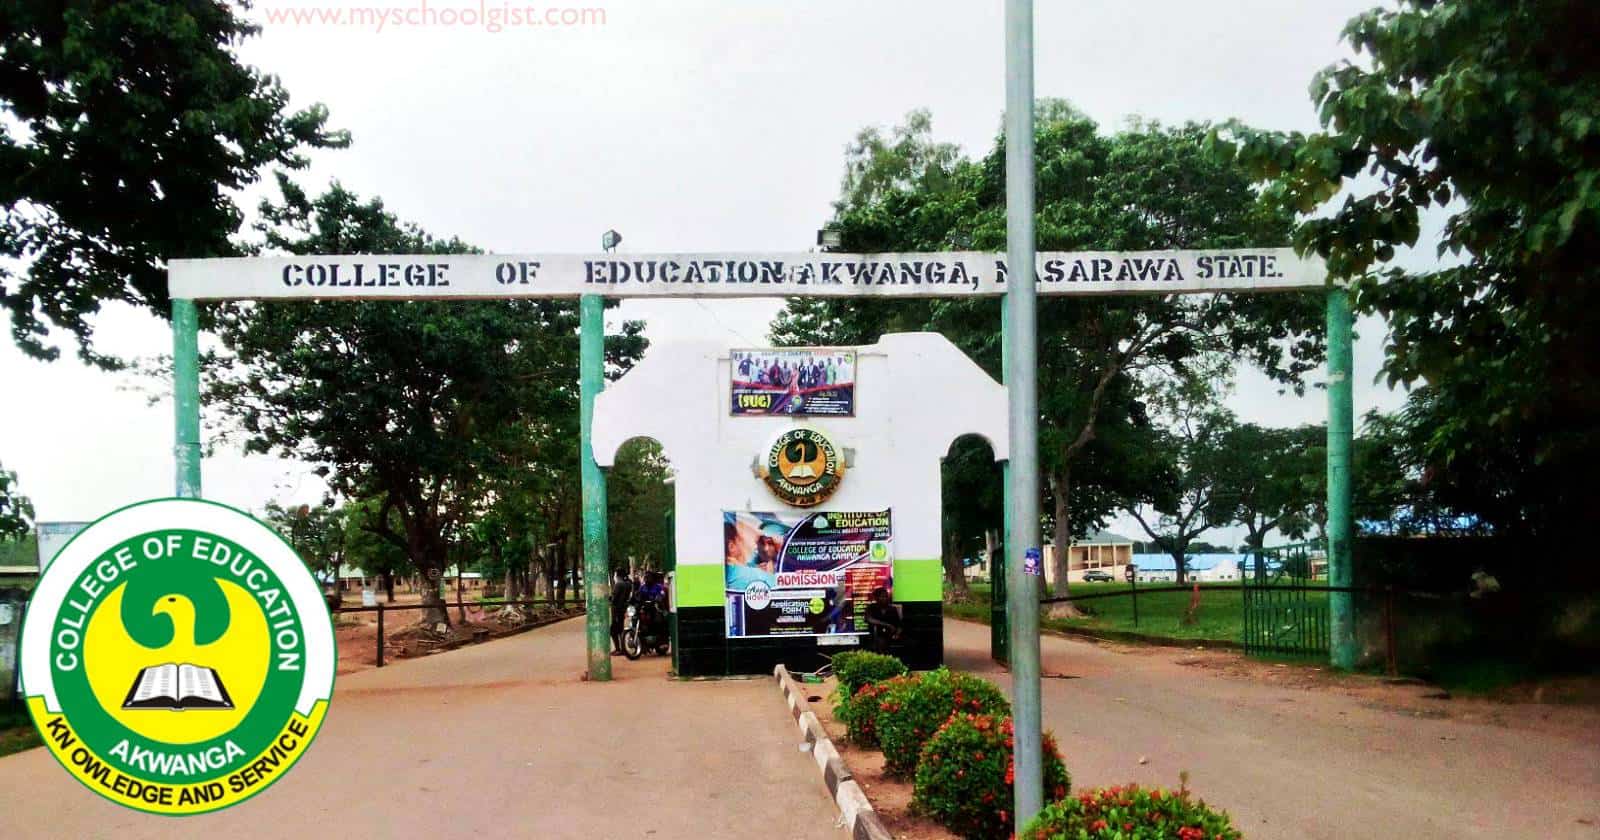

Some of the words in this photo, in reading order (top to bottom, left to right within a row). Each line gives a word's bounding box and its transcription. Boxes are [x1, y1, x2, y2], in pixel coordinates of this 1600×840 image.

[282, 263, 449, 286] COLLEGE
[495, 262, 541, 284] OF
[584, 260, 784, 284] EDUCATION
[995, 257, 1185, 283] NSARAWA
[1195, 255, 1284, 278] STATE.
[794, 430, 806, 439] OF
[836, 518, 888, 527] EDUCATION
[777, 574, 836, 586] ADMISSION
